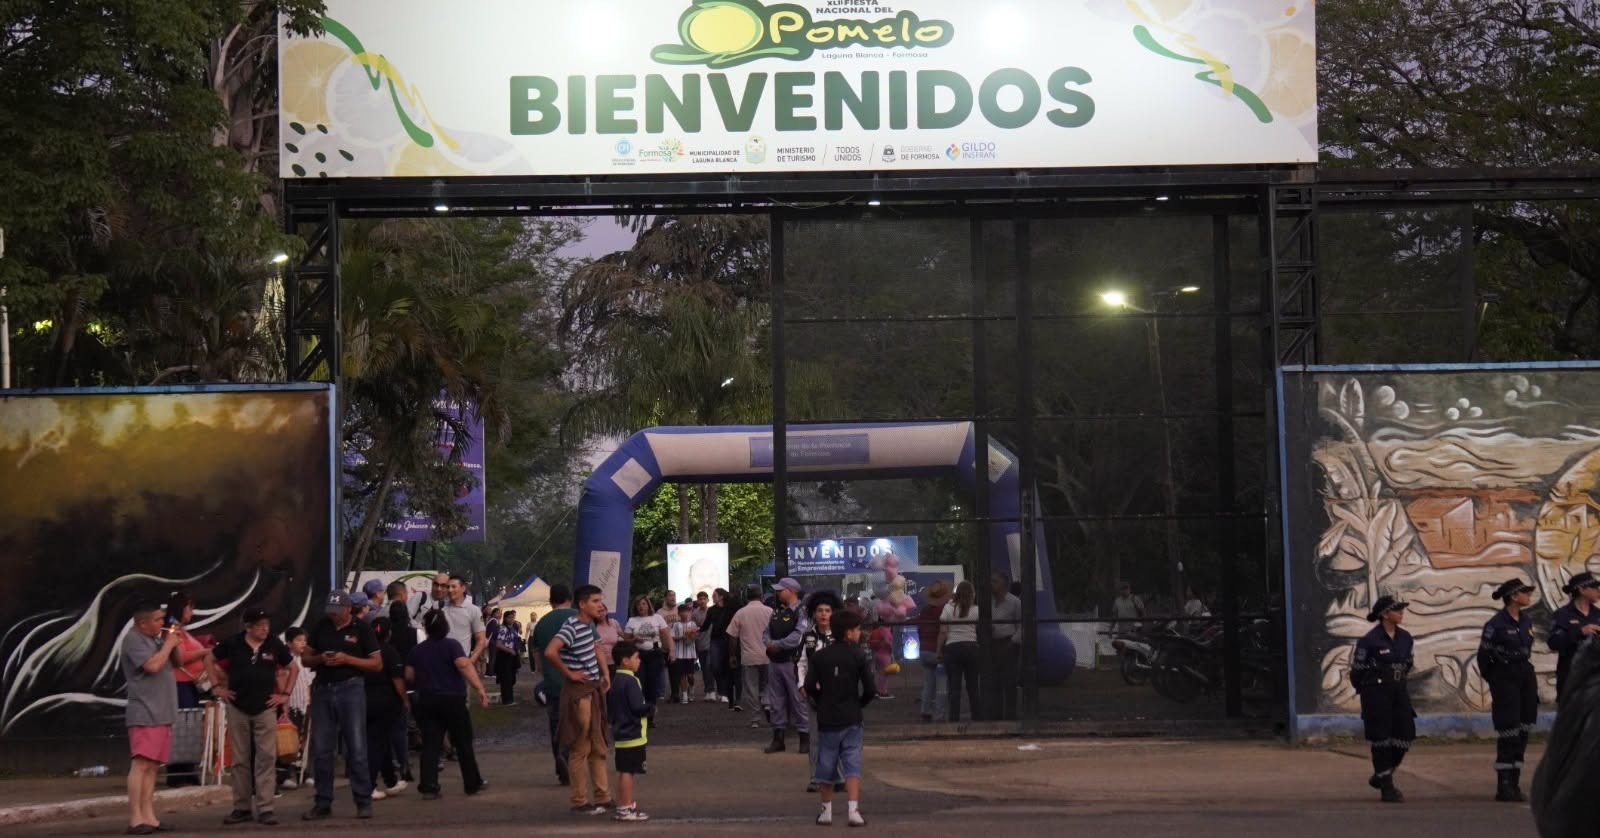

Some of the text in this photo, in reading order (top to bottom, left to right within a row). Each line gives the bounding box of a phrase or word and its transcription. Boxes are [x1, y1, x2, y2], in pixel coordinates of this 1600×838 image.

[770, 11, 944, 43] Pomelo
[821, 52, 853, 60] Laguna
[509, 66, 1096, 136] BIENVENIDOS
[836, 146, 860, 154] TODOS
[962, 142, 996, 152] GILDO
[639, 149, 672, 157] Formosa
[834, 153, 862, 161] UNIDOS
[787, 154, 816, 162] TURISMO
